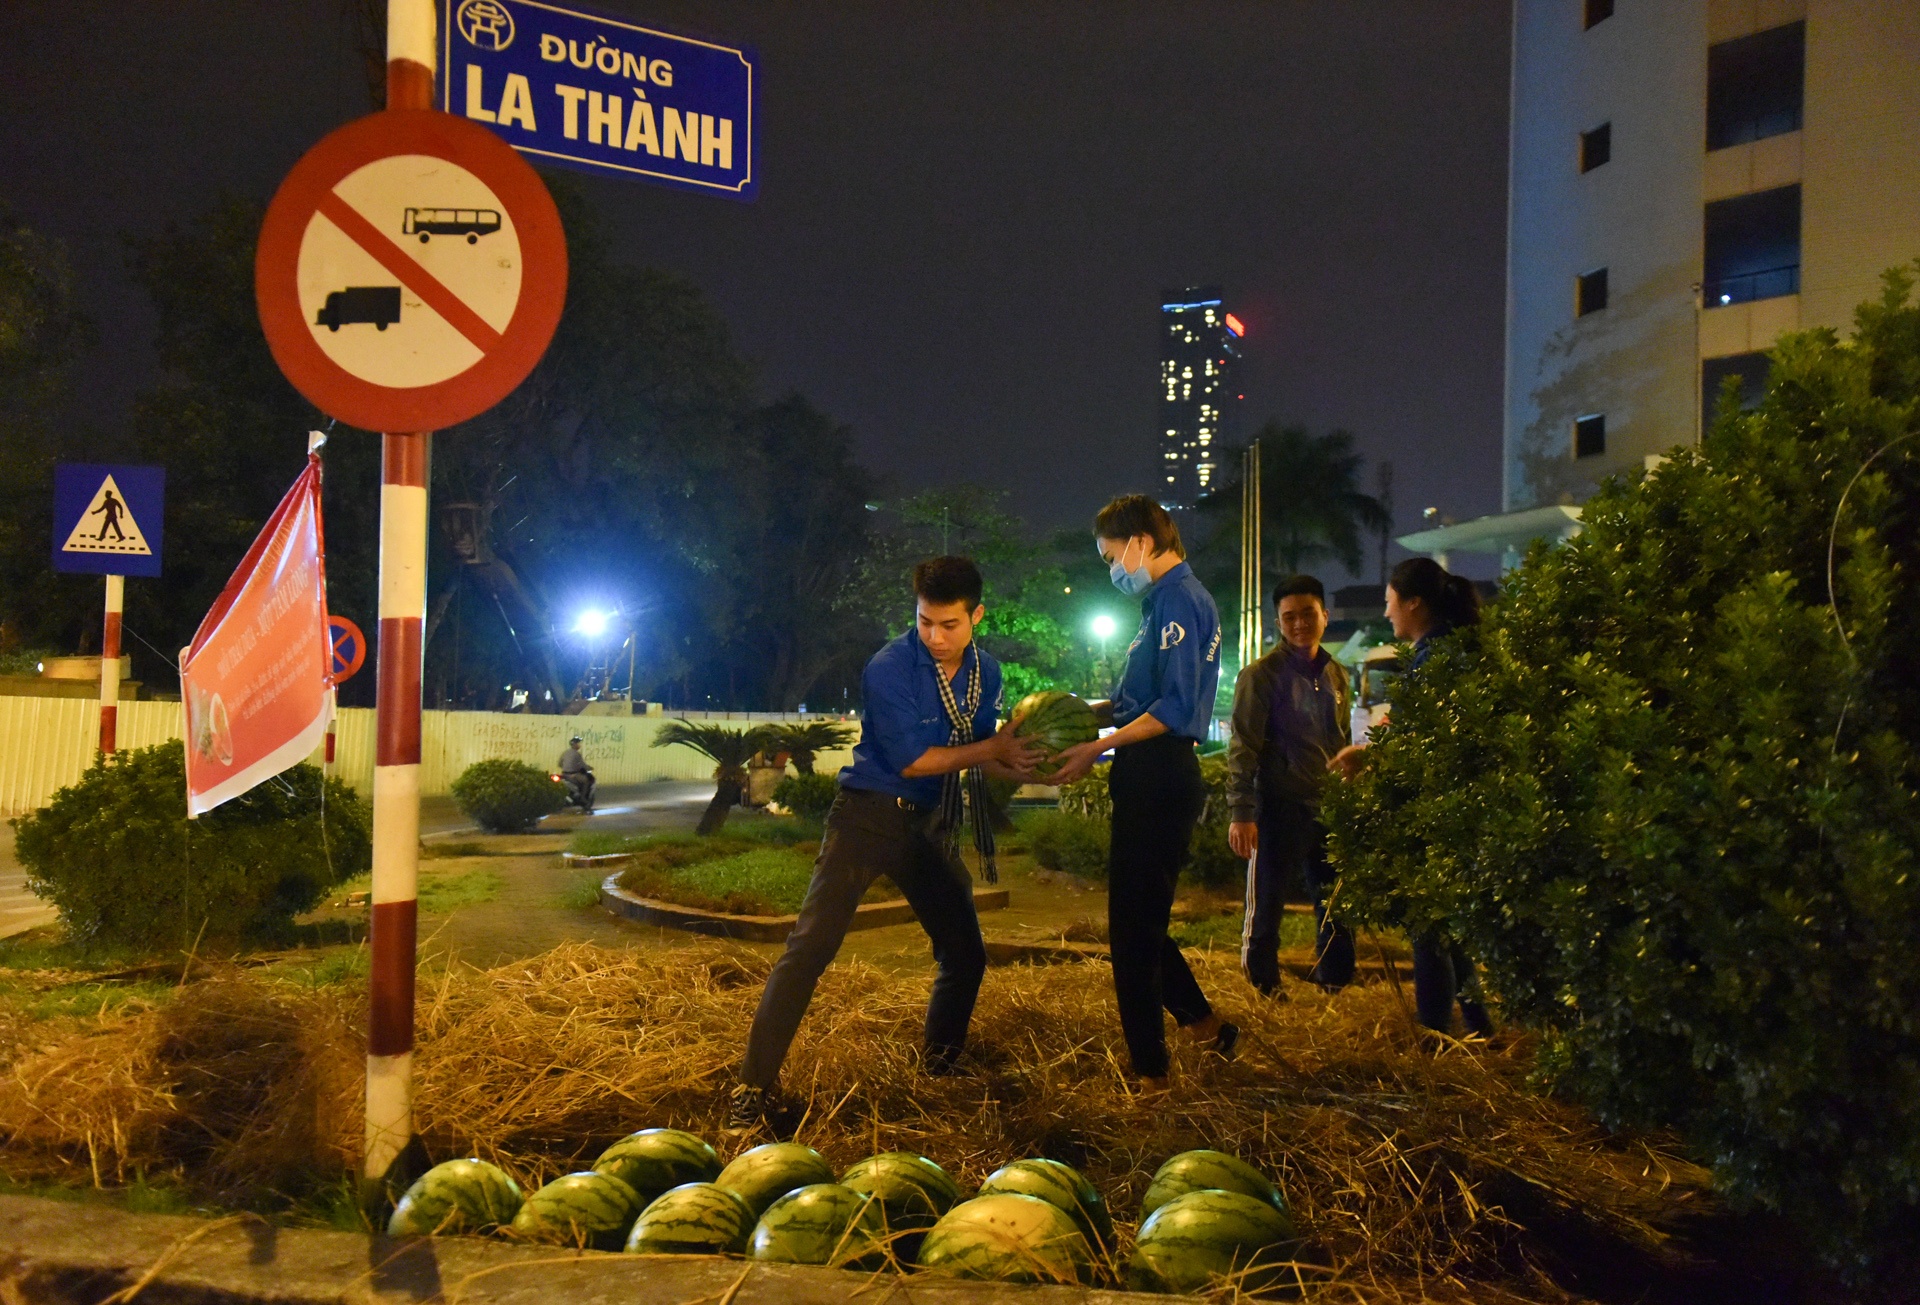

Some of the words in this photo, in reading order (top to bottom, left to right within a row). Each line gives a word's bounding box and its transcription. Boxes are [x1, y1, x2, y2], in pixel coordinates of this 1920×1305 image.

[539, 33, 673, 87] ĐƯỜNG
[466, 63, 537, 131] LA
[555, 83, 733, 170] THÀNH
